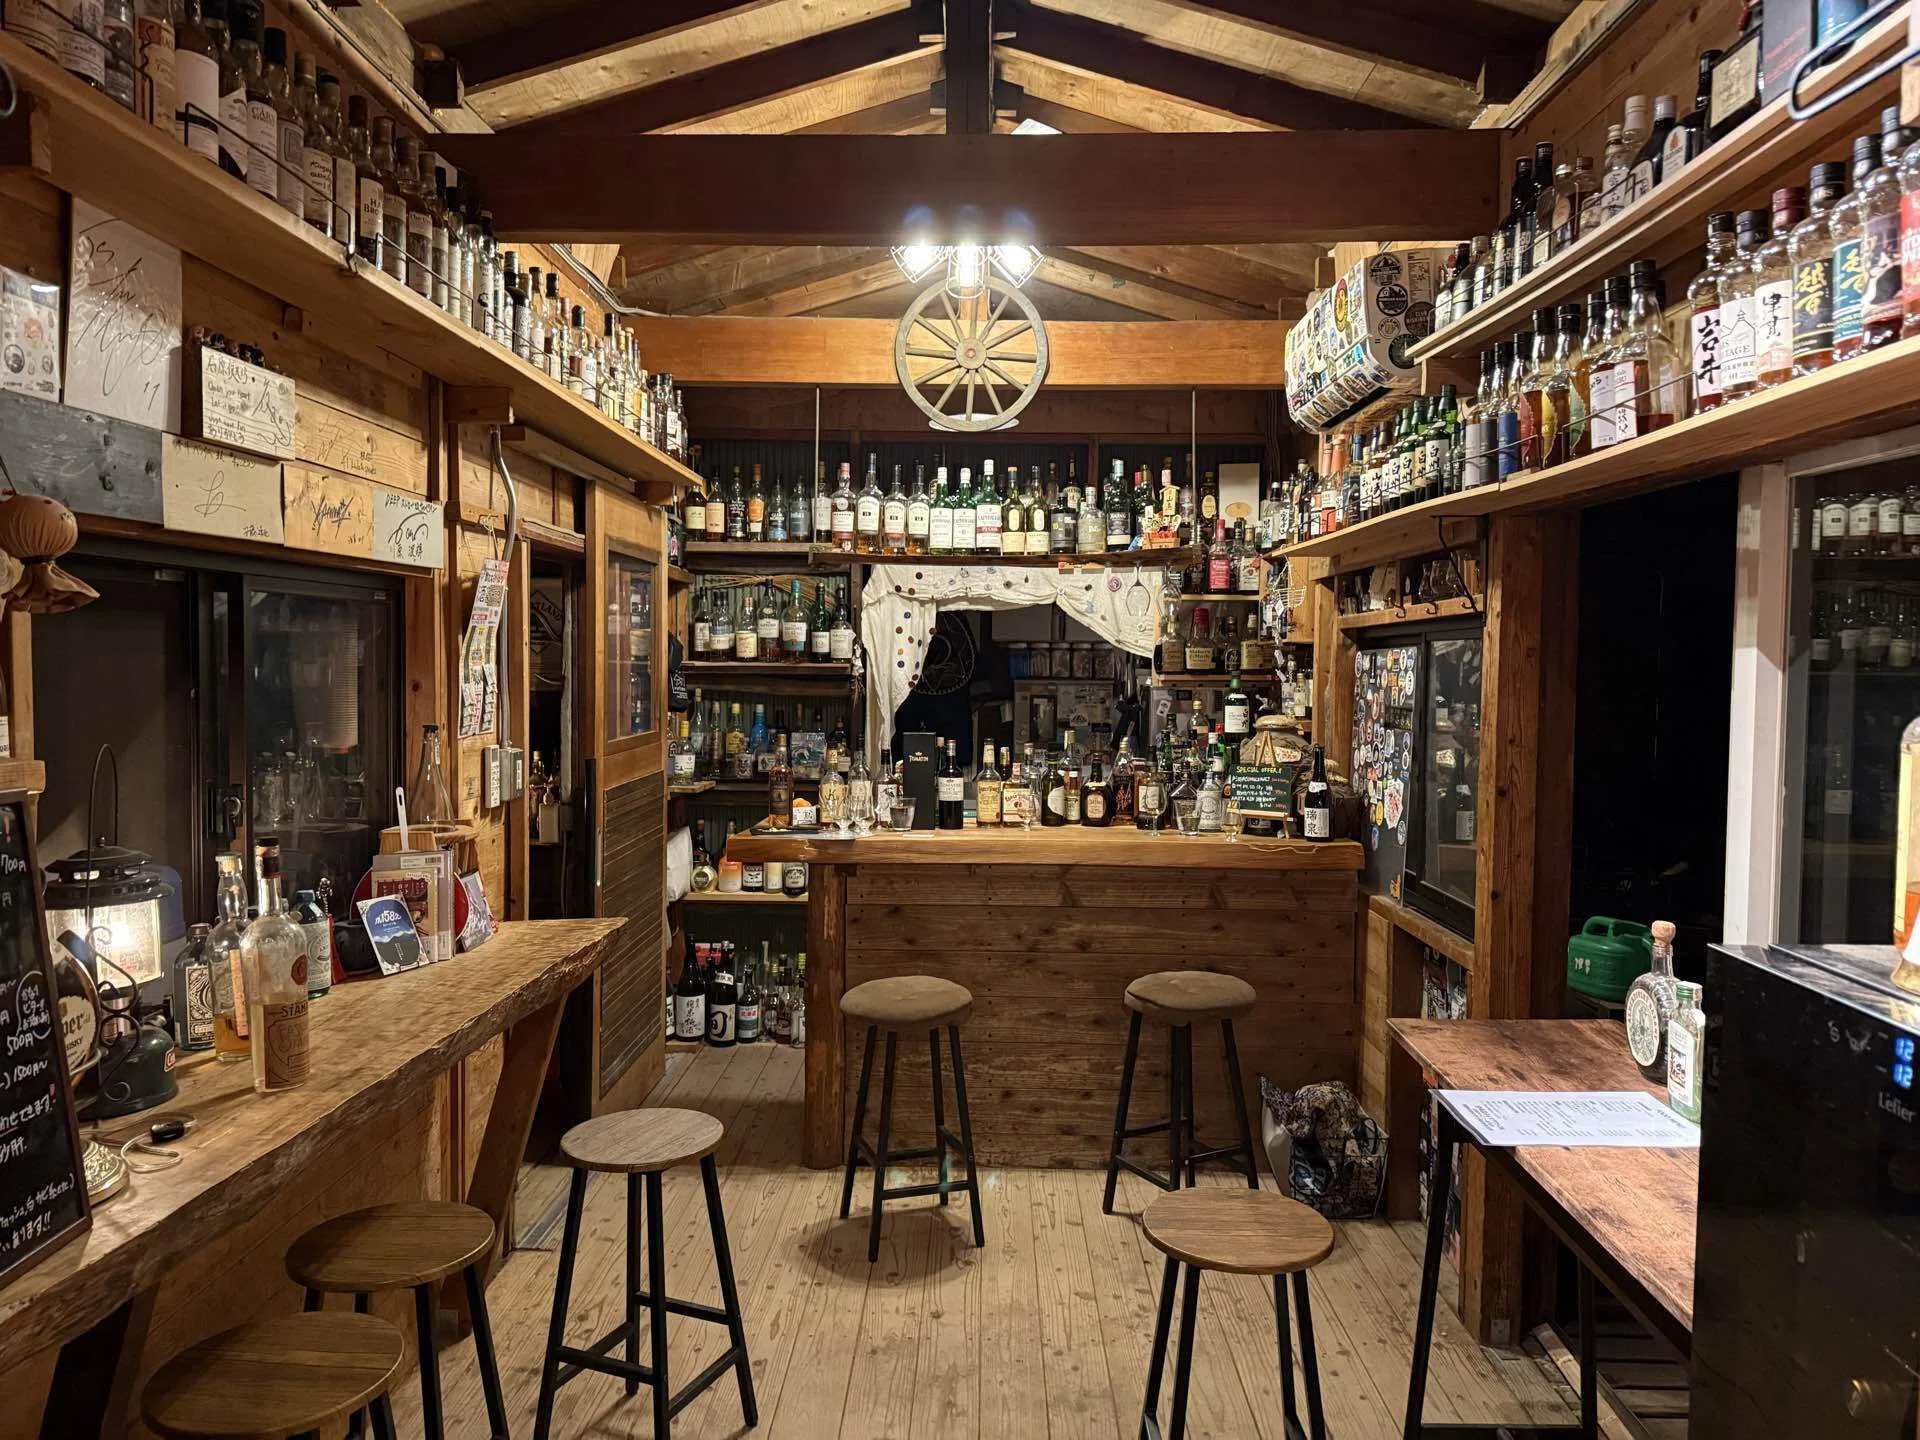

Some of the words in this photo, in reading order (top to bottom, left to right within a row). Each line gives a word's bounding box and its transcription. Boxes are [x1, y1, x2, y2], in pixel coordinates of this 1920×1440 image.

[1698, 315, 1721, 384] 岩井
[1402, 456, 1413, 485] 白州
[1895, 1038, 1915, 1061] 12
[1893, 1064, 1914, 1088] 12
